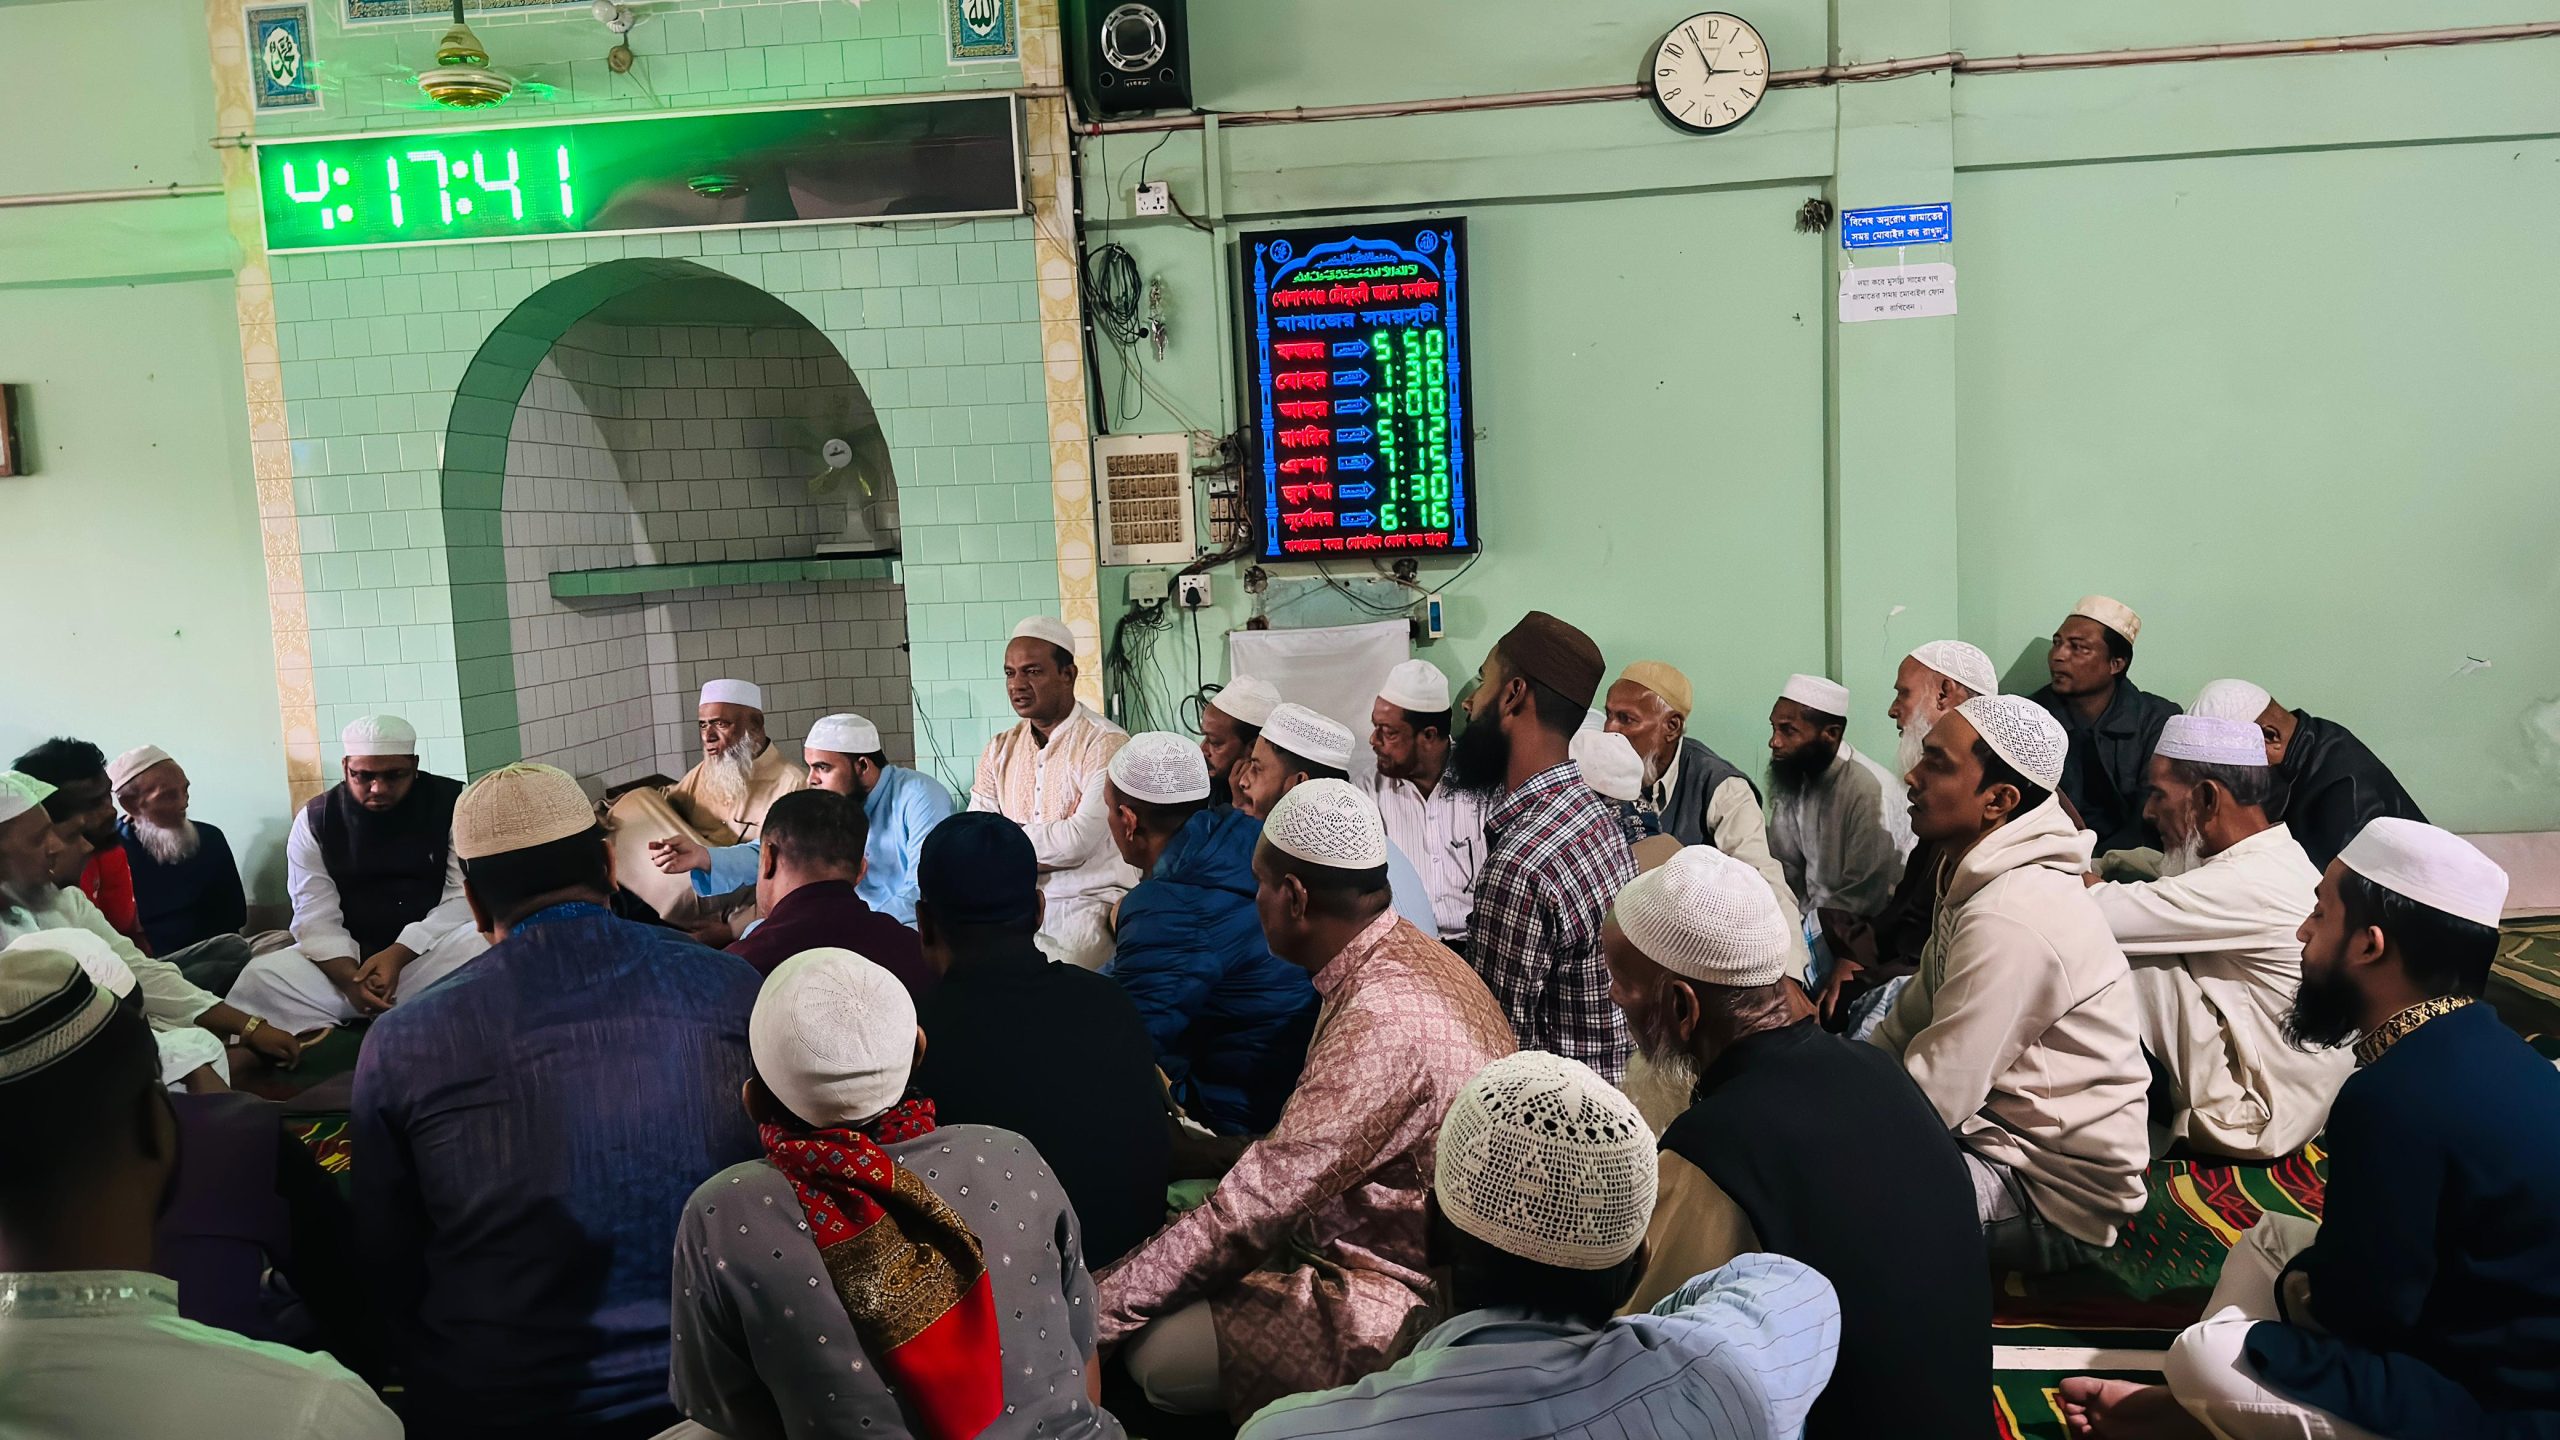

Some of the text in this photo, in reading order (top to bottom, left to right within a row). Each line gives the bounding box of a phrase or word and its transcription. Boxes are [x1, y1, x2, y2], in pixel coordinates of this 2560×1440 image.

[1685, 25, 1699, 44] 11
[1708, 19, 1719, 39] 12
[1729, 27, 1740, 45] 1
[1665, 42, 1684, 58] 10
[1739, 44, 1758, 58] 2
[1657, 68, 1678, 77] 9
[1743, 68, 1764, 76] 3
[1663, 87, 1682, 101] 8
[1739, 87, 1756, 99] 4
[1680, 100, 1695, 118] 7
[1704, 105, 1713, 125] 6
[1723, 100, 1737, 119] 5
[1850, 212, 1943, 227] বিশেষ অনুরোধ জামাতের
[1851, 232, 1869, 241] সময়
[1872, 229, 1904, 240] মোবাইল
[1274, 303, 1439, 332] নামাজের সময়সূচী
[1386, 359, 1443, 388] 1:30
[1377, 387, 1445, 416] 4:00
[1378, 416, 1446, 446] 5:12
[1380, 445, 1447, 472] 7:15
[1389, 473, 1448, 502] 1:30
[1381, 501, 1449, 532] 6:16
